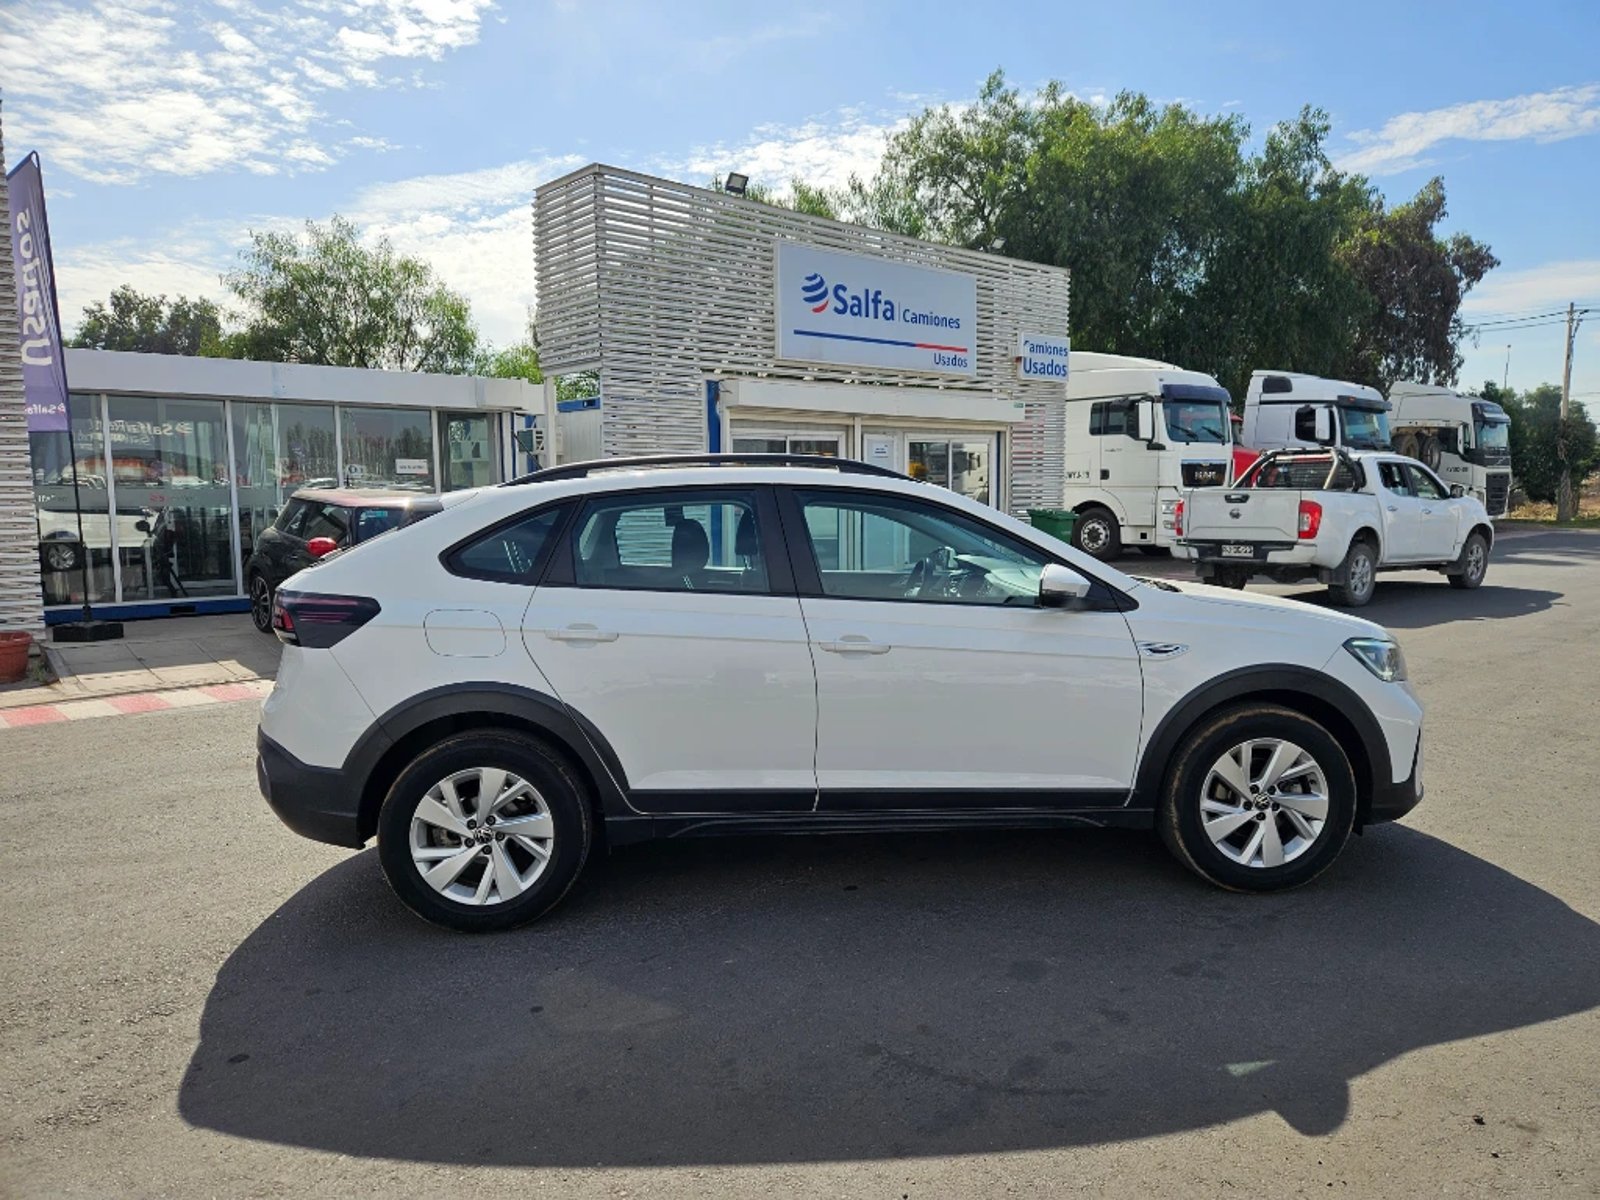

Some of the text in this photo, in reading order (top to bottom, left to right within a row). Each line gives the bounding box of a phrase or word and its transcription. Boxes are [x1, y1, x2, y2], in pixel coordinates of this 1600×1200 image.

[833, 284, 961, 329] Salfa Camiones
[934, 353, 968, 368] Usados
[1023, 356, 1068, 377] Usados
